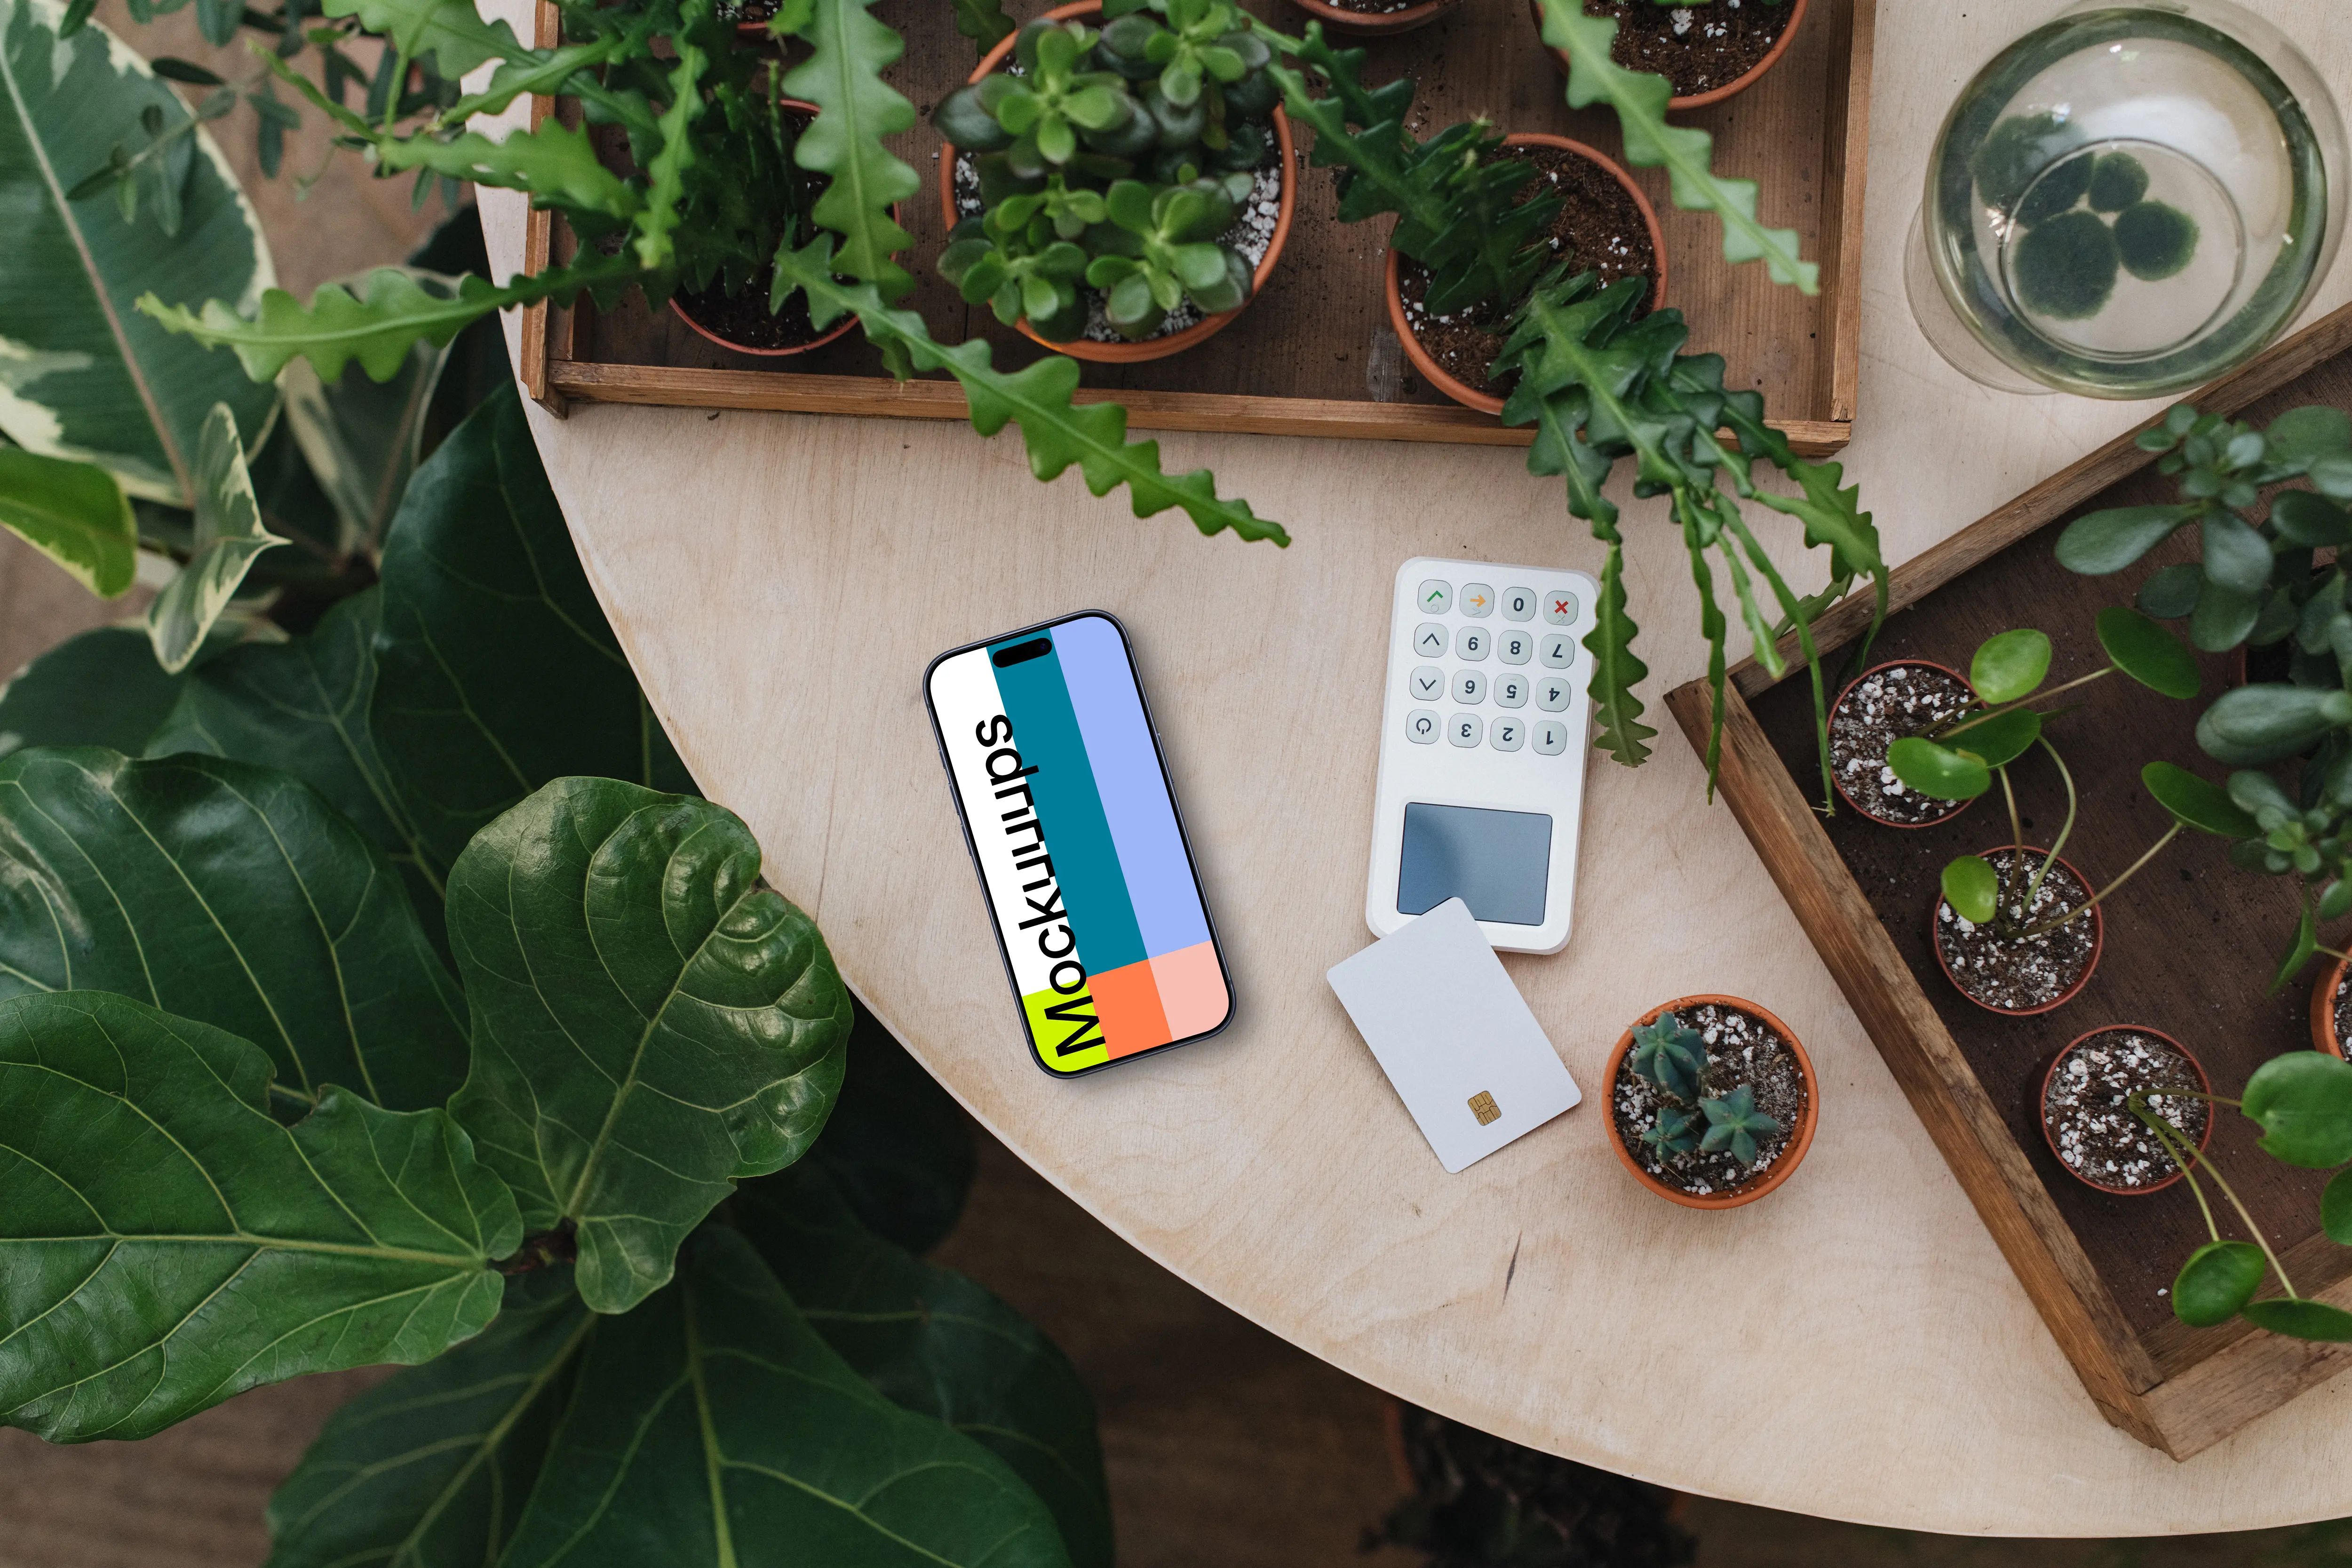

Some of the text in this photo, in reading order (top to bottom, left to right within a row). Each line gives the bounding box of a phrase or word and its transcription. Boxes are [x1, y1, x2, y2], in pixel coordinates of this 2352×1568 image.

[1513, 597, 1524, 612] 0
[1468, 637, 1563, 659] 7 8 9
[1465, 680, 1560, 702] 4 5 6
[1461, 724, 1554, 745] 1 2 3
[976, 715, 1106, 1057] Mockuuups
